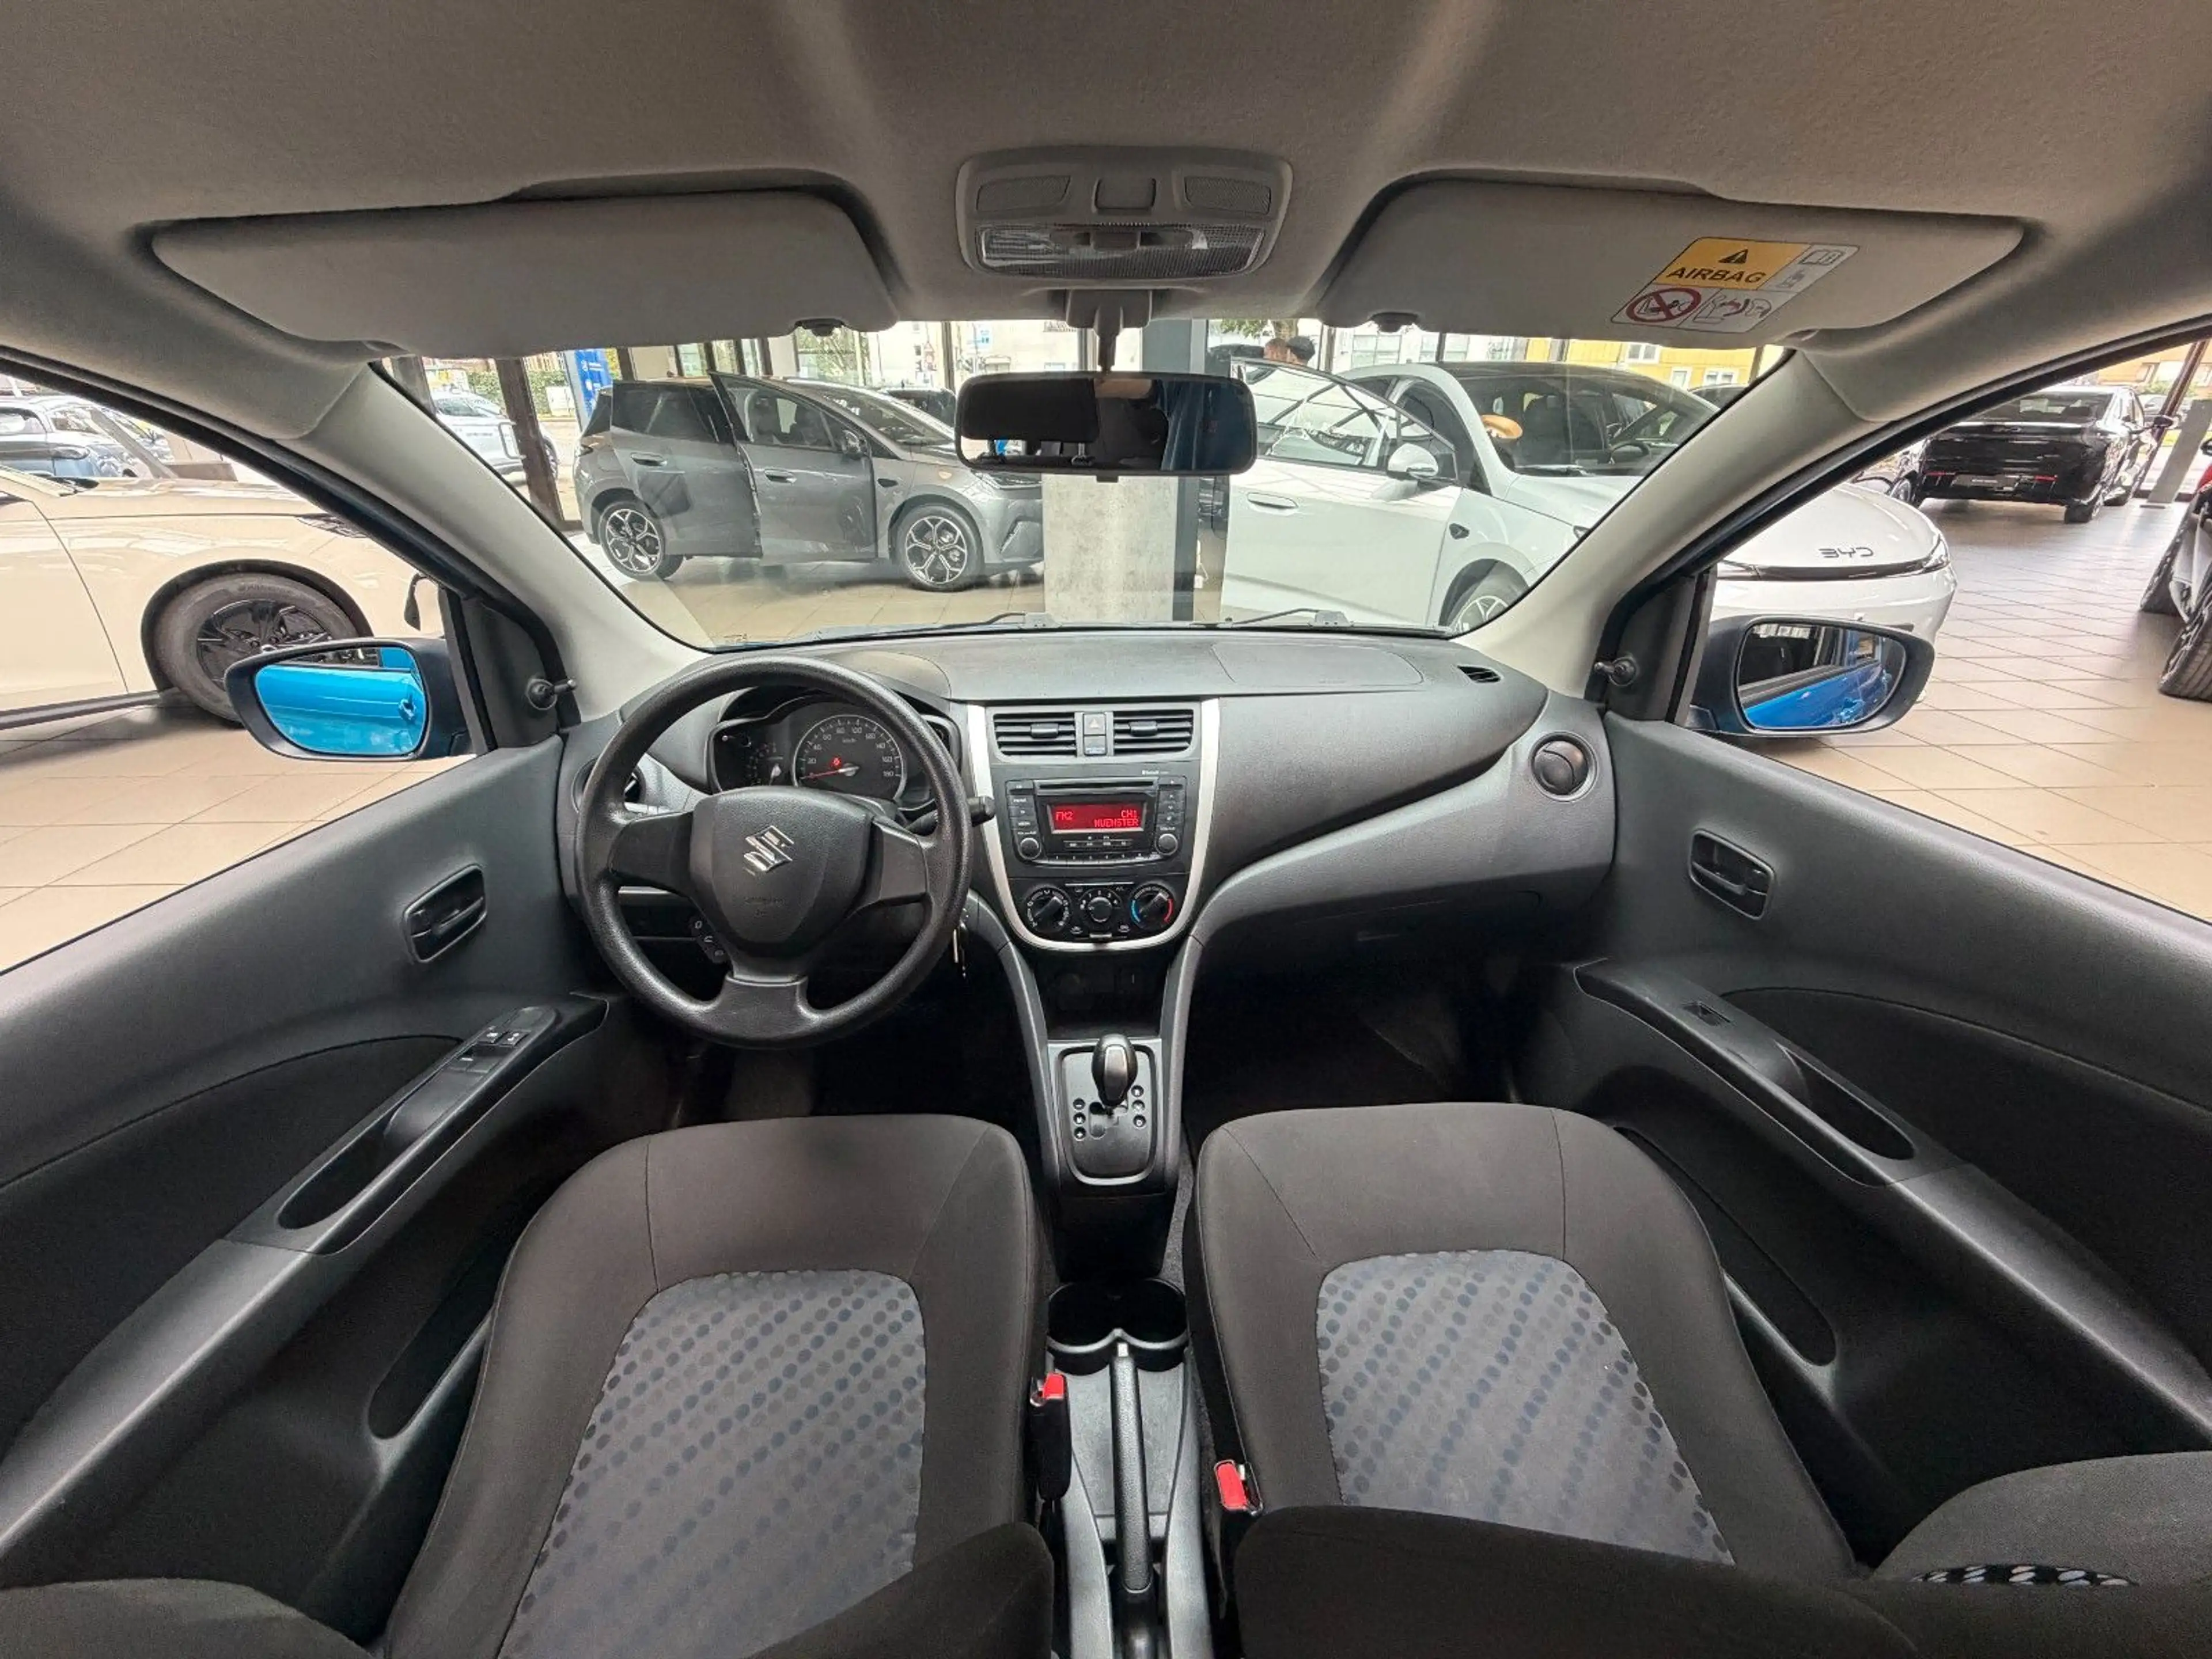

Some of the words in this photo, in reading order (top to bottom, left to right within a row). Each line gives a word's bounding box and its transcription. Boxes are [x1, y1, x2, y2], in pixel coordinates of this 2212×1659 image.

[1666, 267, 1766, 283] AIRBAG
[1818, 547, 1874, 558] BYD
[1055, 811, 1074, 821] FM2
[1121, 809, 1138, 819] CH1
